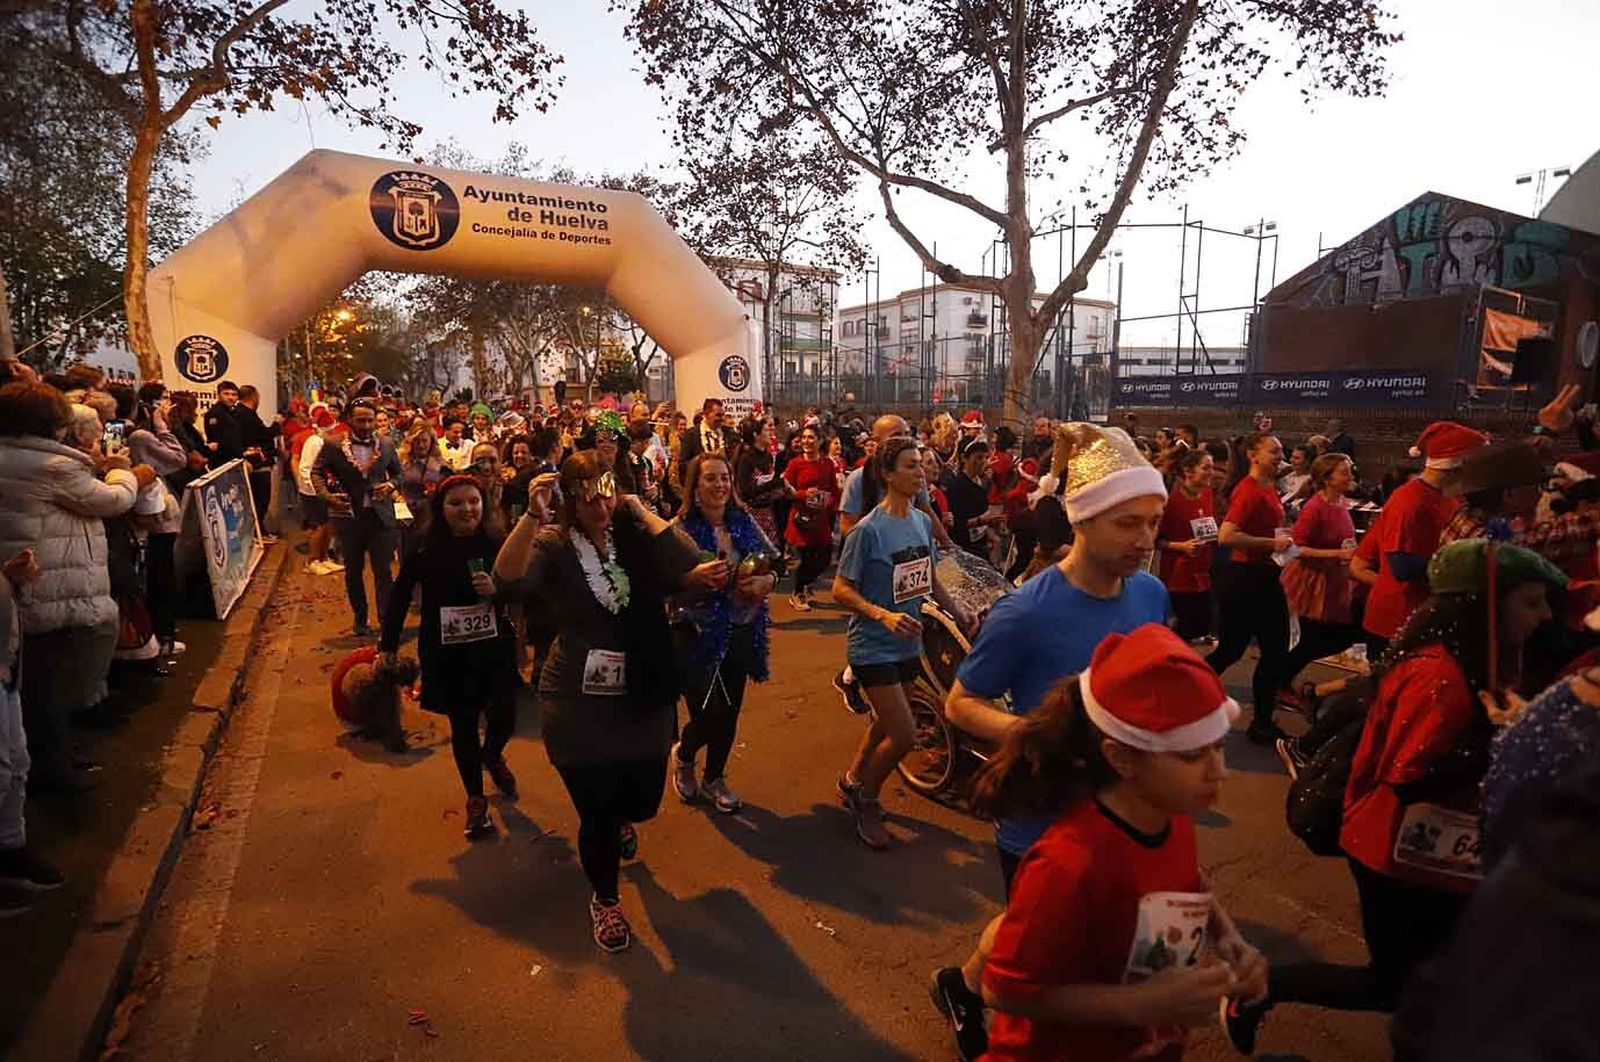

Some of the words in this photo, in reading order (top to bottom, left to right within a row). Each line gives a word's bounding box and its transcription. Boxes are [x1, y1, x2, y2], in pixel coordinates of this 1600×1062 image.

[463, 185, 608, 213] Ayuntamiento
[507, 207, 533, 222] de
[540, 209, 609, 231] Huelva
[541, 230, 555, 240] de
[559, 231, 611, 245] Deportes
[1197, 382, 1238, 391] HYUNDAI
[1280, 380, 1330, 389] HYUNDAI
[1366, 376, 1426, 388] HYUNDAI
[909, 569, 928, 588] 374
[463, 614, 491, 632] 329
